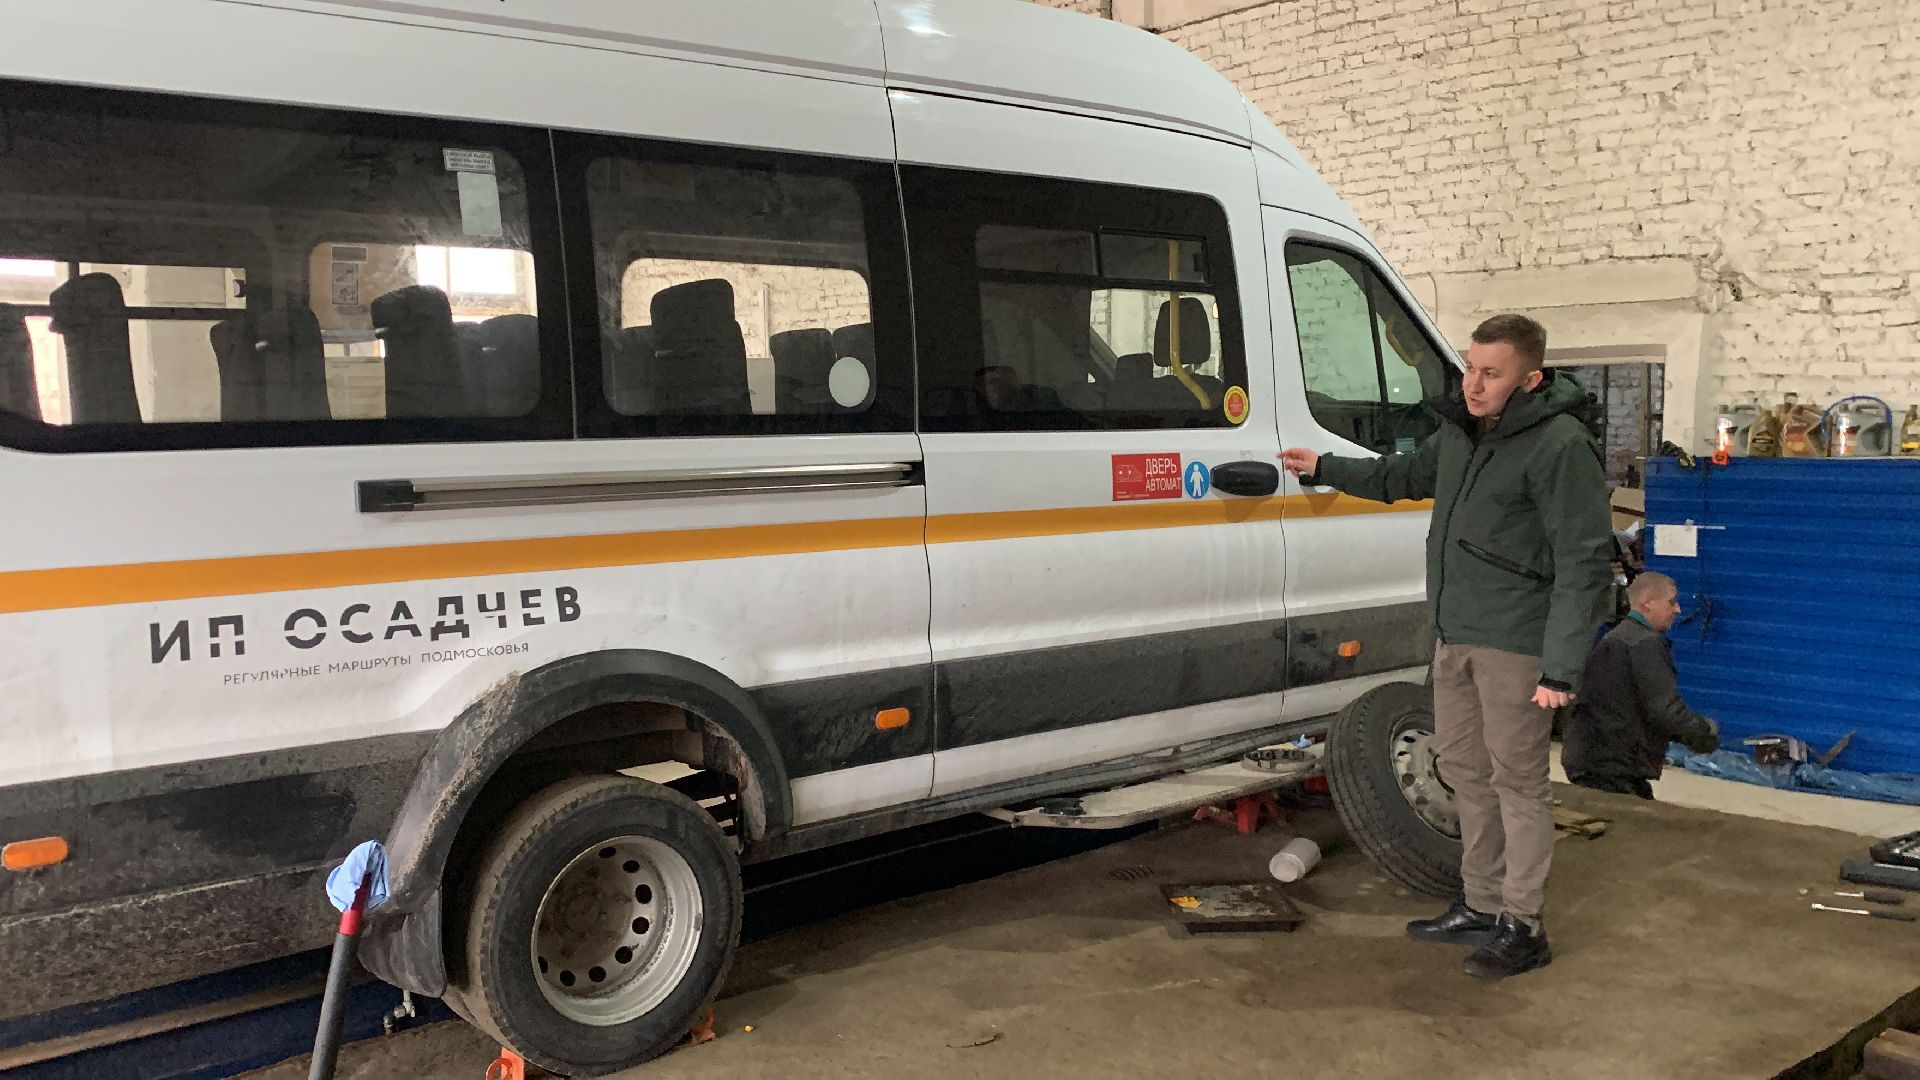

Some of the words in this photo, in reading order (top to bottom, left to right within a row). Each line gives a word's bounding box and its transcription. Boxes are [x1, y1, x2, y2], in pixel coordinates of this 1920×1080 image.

[1145, 457, 1177, 477] ДВЕРЬ
[1145, 477, 1181, 492] АВТОМАТ
[149, 615, 246, 664] ИП
[283, 586, 582, 650] ОСАДЧЕВ
[328, 654, 412, 675] МАРШРУТЫ
[421, 642, 529, 664] ПОДМОСКОВЬЯ
